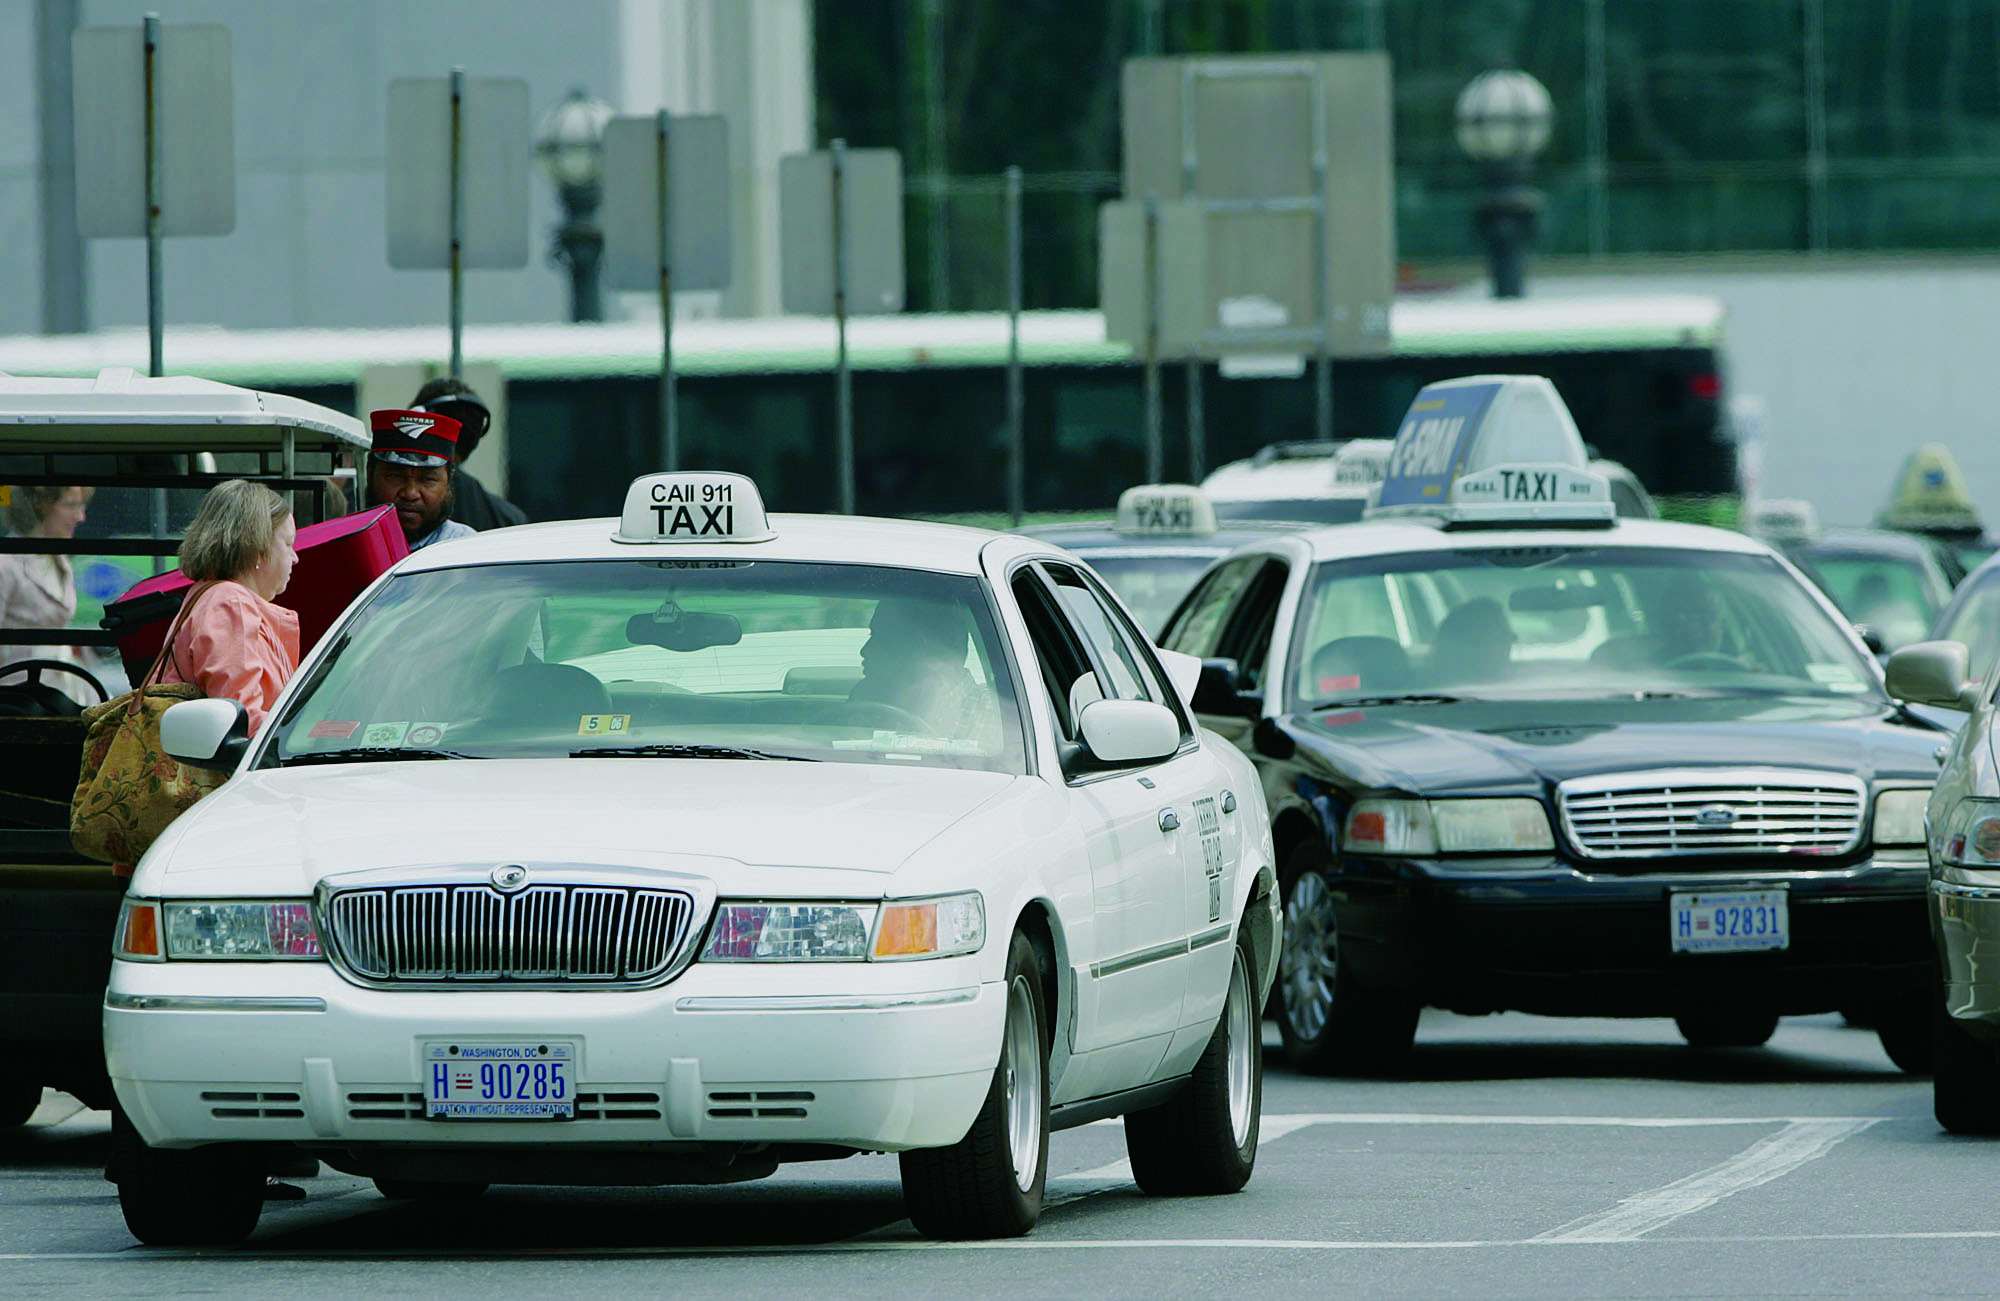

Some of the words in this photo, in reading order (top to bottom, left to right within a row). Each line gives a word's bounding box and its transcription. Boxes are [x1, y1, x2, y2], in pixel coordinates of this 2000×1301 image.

[702, 484, 732, 502] 911
[1463, 481, 1497, 493] CALL
[1500, 471, 1557, 501] TAXI
[650, 505, 733, 535] TAXI
[1135, 506, 1193, 528] TAXI
[588, 716, 599, 729] 5
[610, 716, 623, 730] 06
[1678, 909, 1692, 937] H
[1714, 906, 1779, 936] 92831
[461, 1048, 522, 1058] WASHINGTON,
[524, 1048, 538, 1058] DC
[433, 1063, 449, 1099] H
[480, 1063, 565, 1100] 90285
